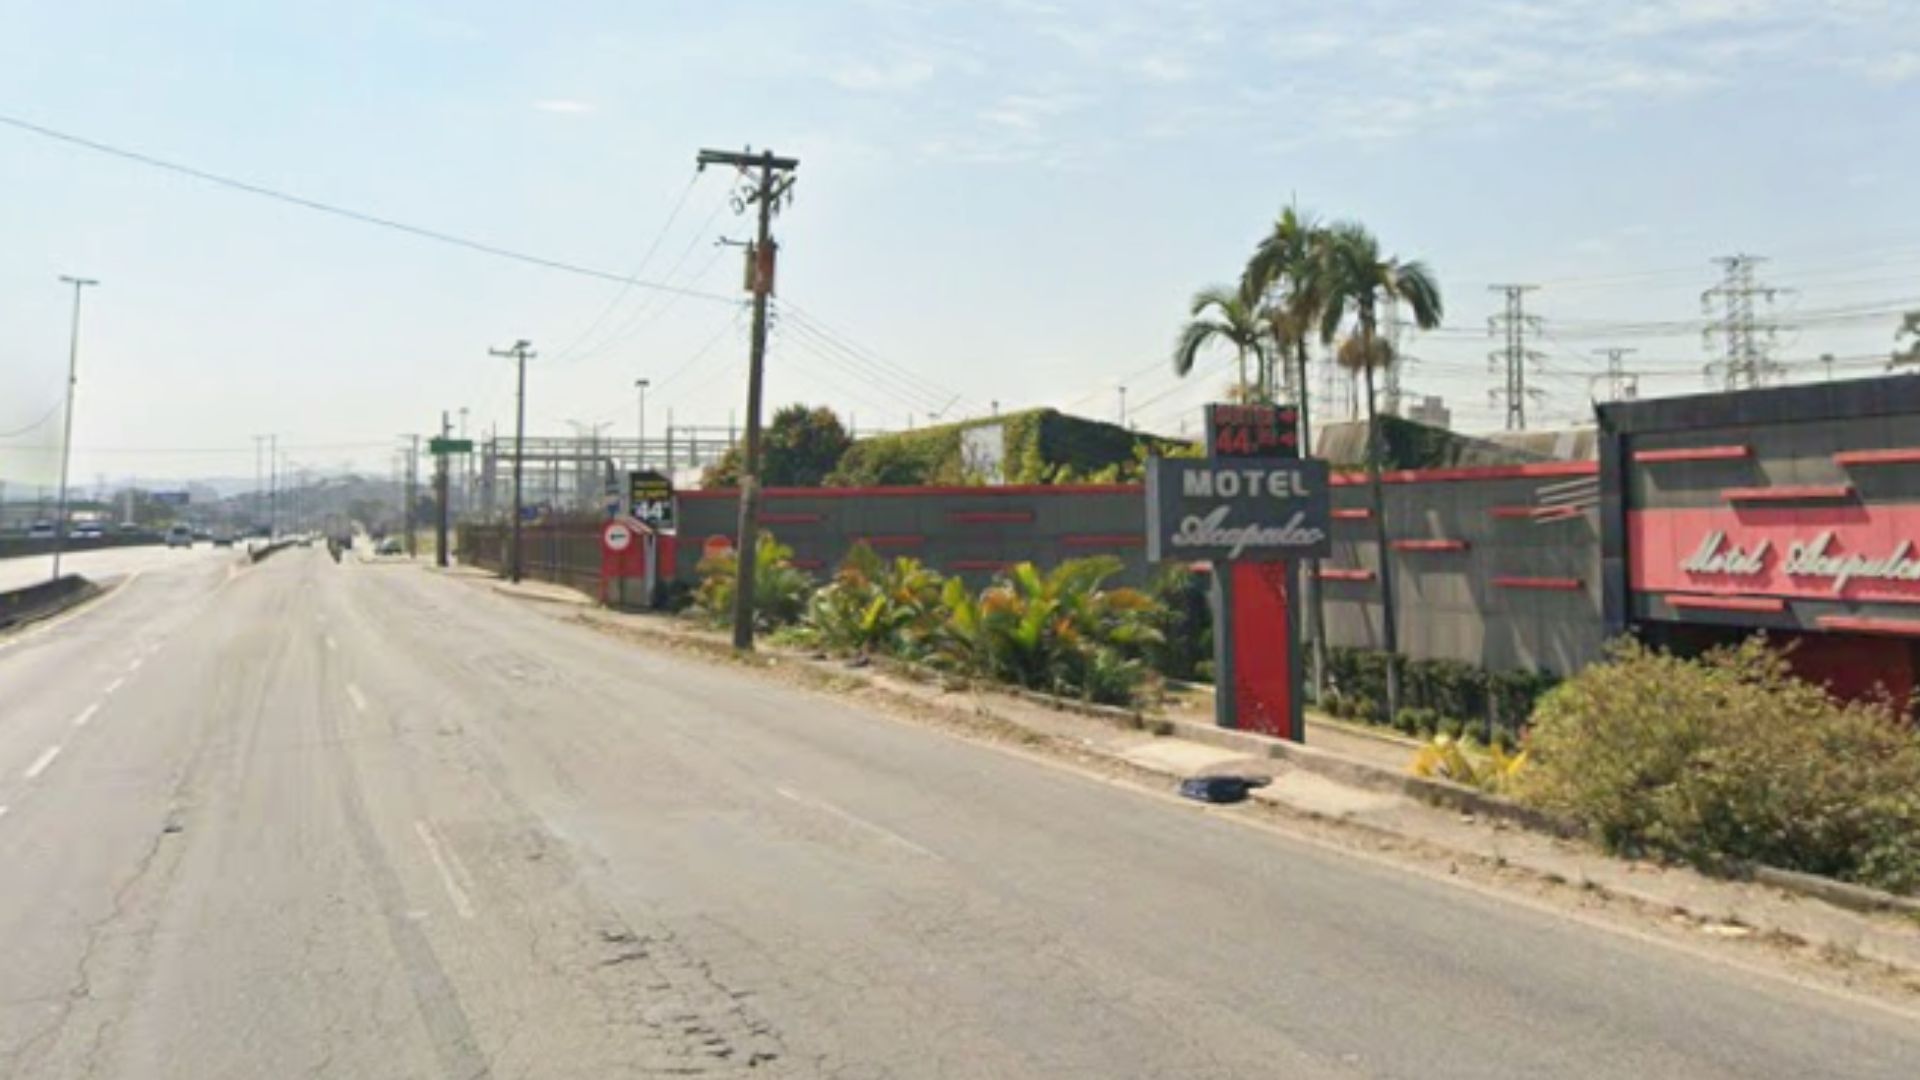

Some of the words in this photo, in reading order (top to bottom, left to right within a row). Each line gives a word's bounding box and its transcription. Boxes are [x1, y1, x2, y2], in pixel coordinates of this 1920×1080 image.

[1182, 469, 1310, 498] MOTEL
[1171, 505, 1326, 560] Acapulco
[1680, 530, 1772, 576] Motel
